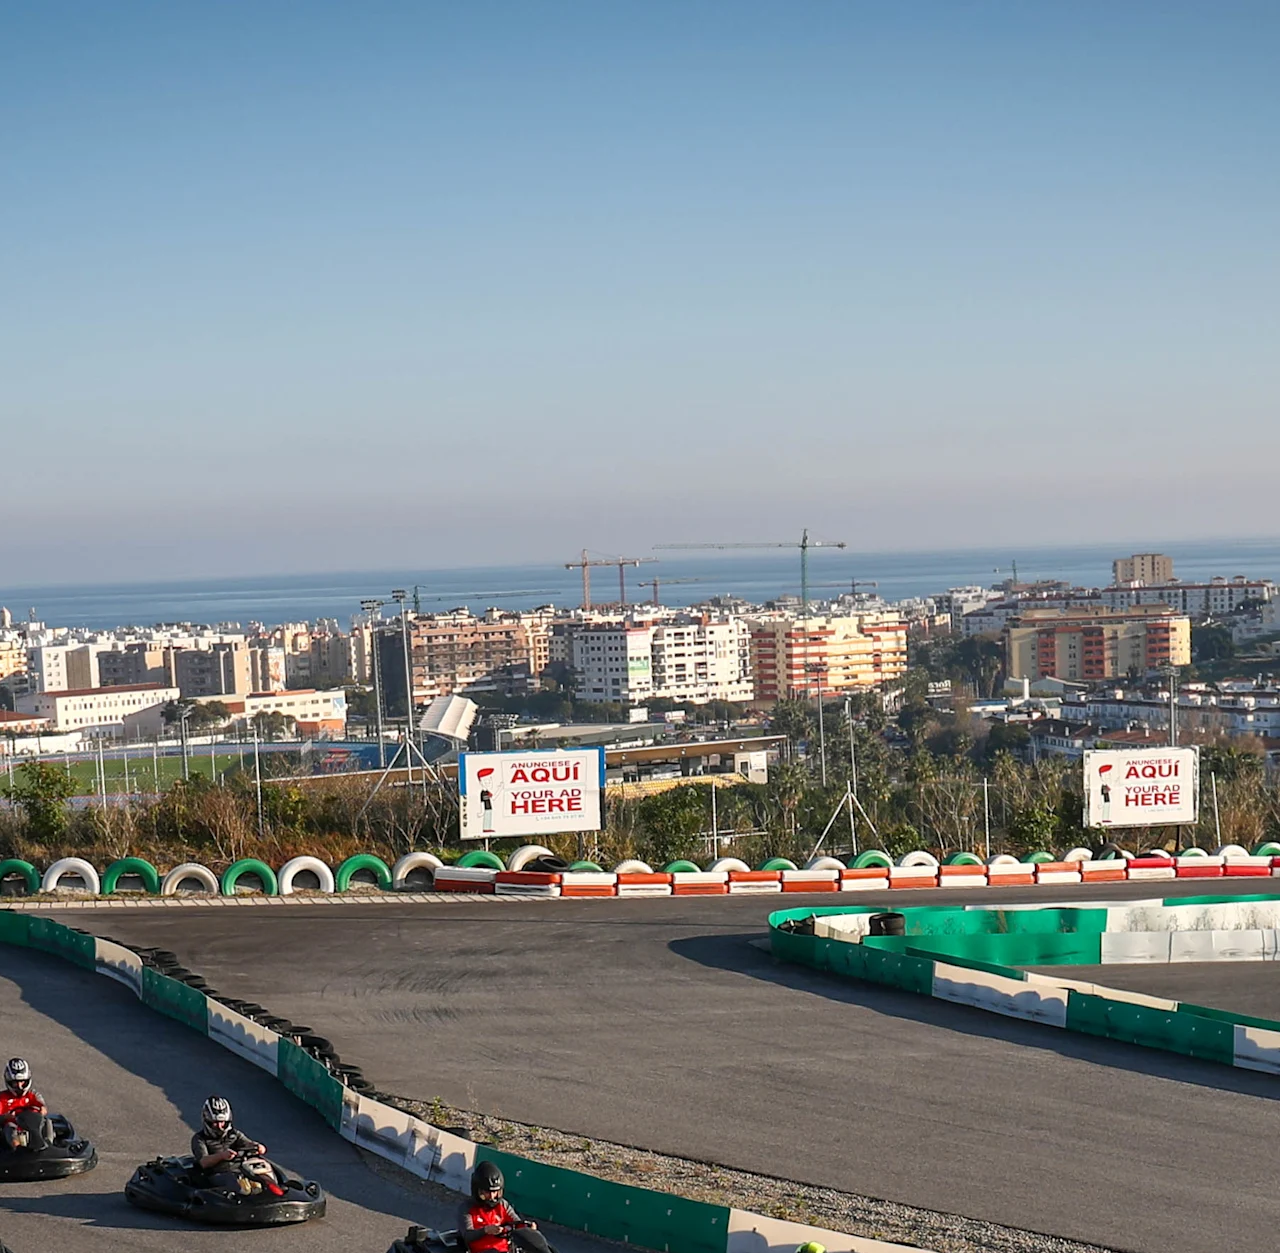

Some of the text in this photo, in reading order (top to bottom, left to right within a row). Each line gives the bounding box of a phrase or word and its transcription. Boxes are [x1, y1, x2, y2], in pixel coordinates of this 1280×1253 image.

[510, 760, 571, 768] ANUNCIESE
[1125, 760, 1180, 779] AQUÍ
[510, 762, 580, 783] AQUÍ
[511, 789, 581, 800] YOUR AD
[1125, 784, 1180, 794] YOUR AD
[511, 797, 582, 814] HERE
[1125, 792, 1180, 807] HERE
